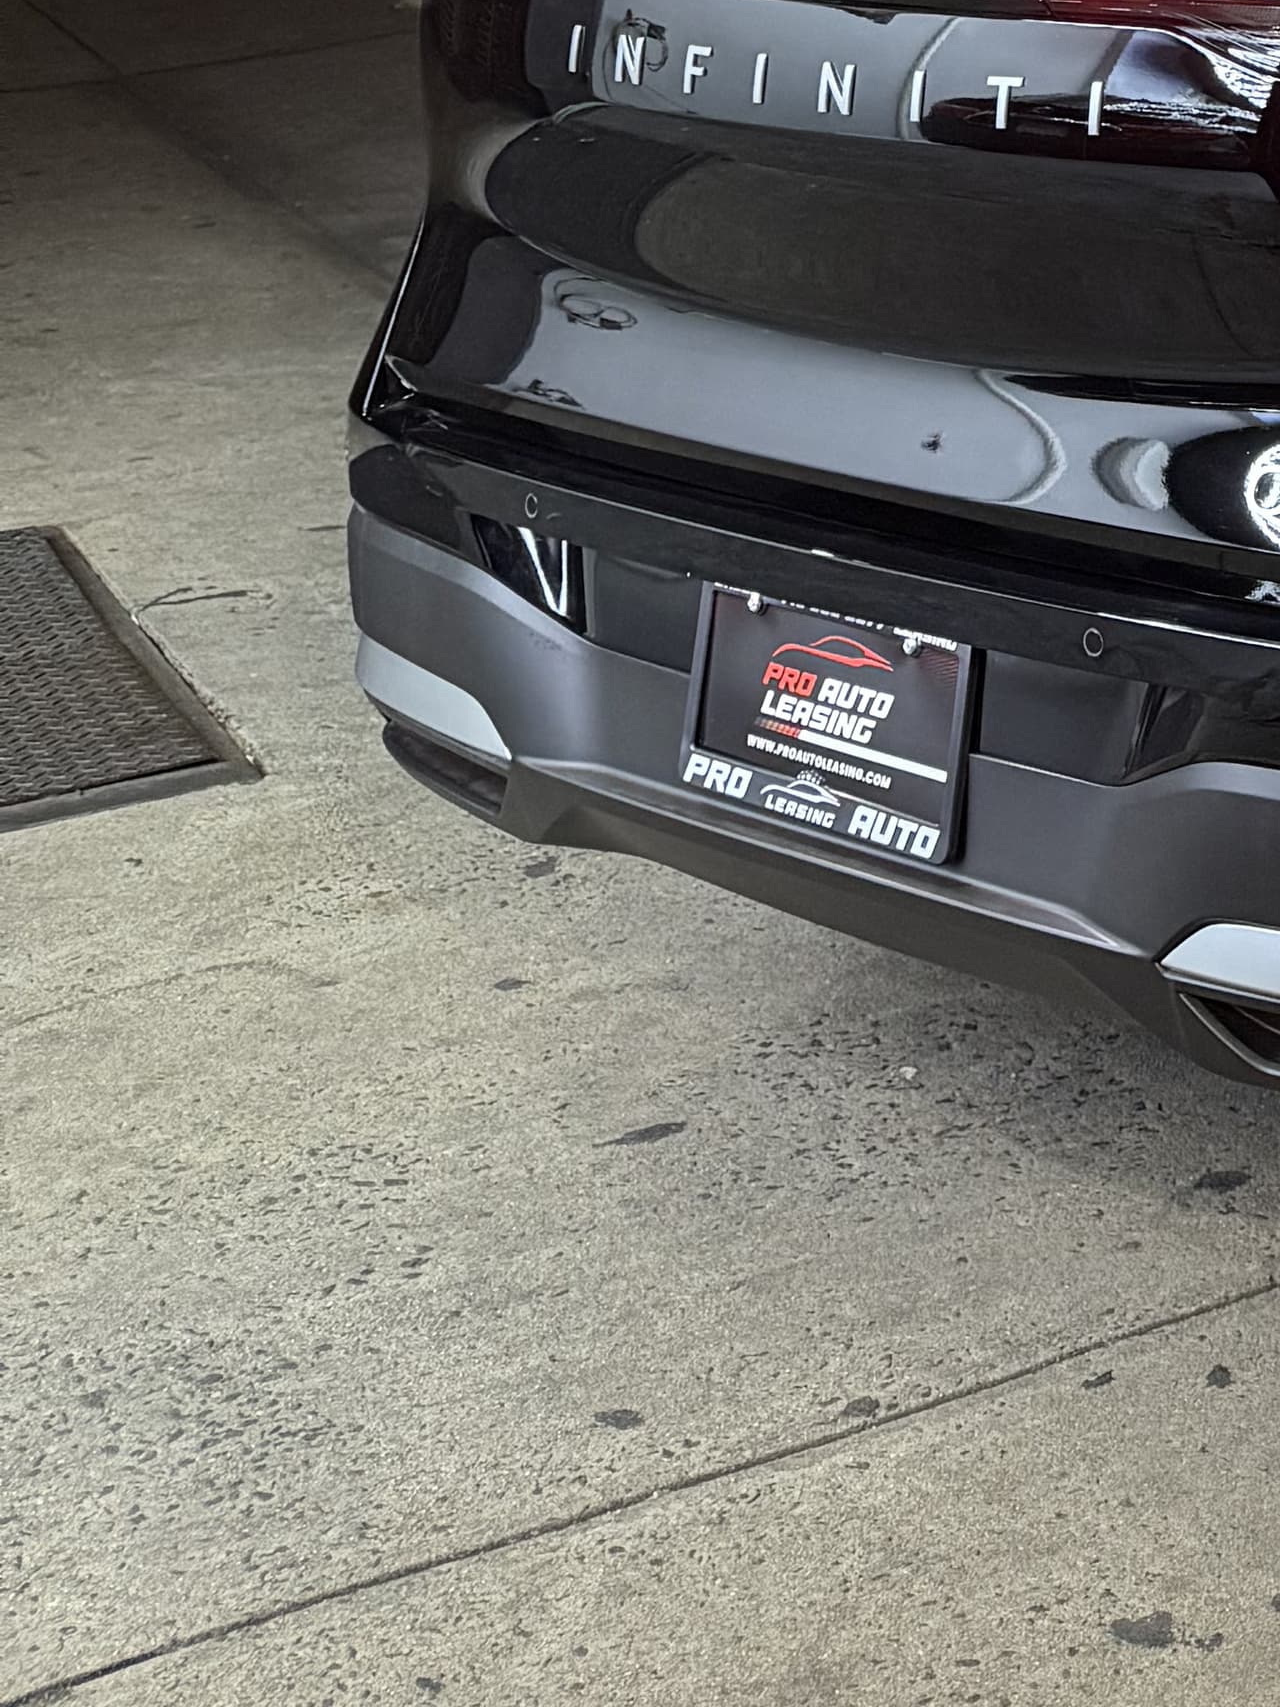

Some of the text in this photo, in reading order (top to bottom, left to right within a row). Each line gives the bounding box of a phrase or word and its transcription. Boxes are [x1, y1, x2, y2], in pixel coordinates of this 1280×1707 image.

[568, 24, 1104, 136] INFINITI
[760, 689, 877, 745] LEASING
[761, 661, 896, 720] PRO AUTO
[682, 752, 942, 860] PRO LEASING AUTO
